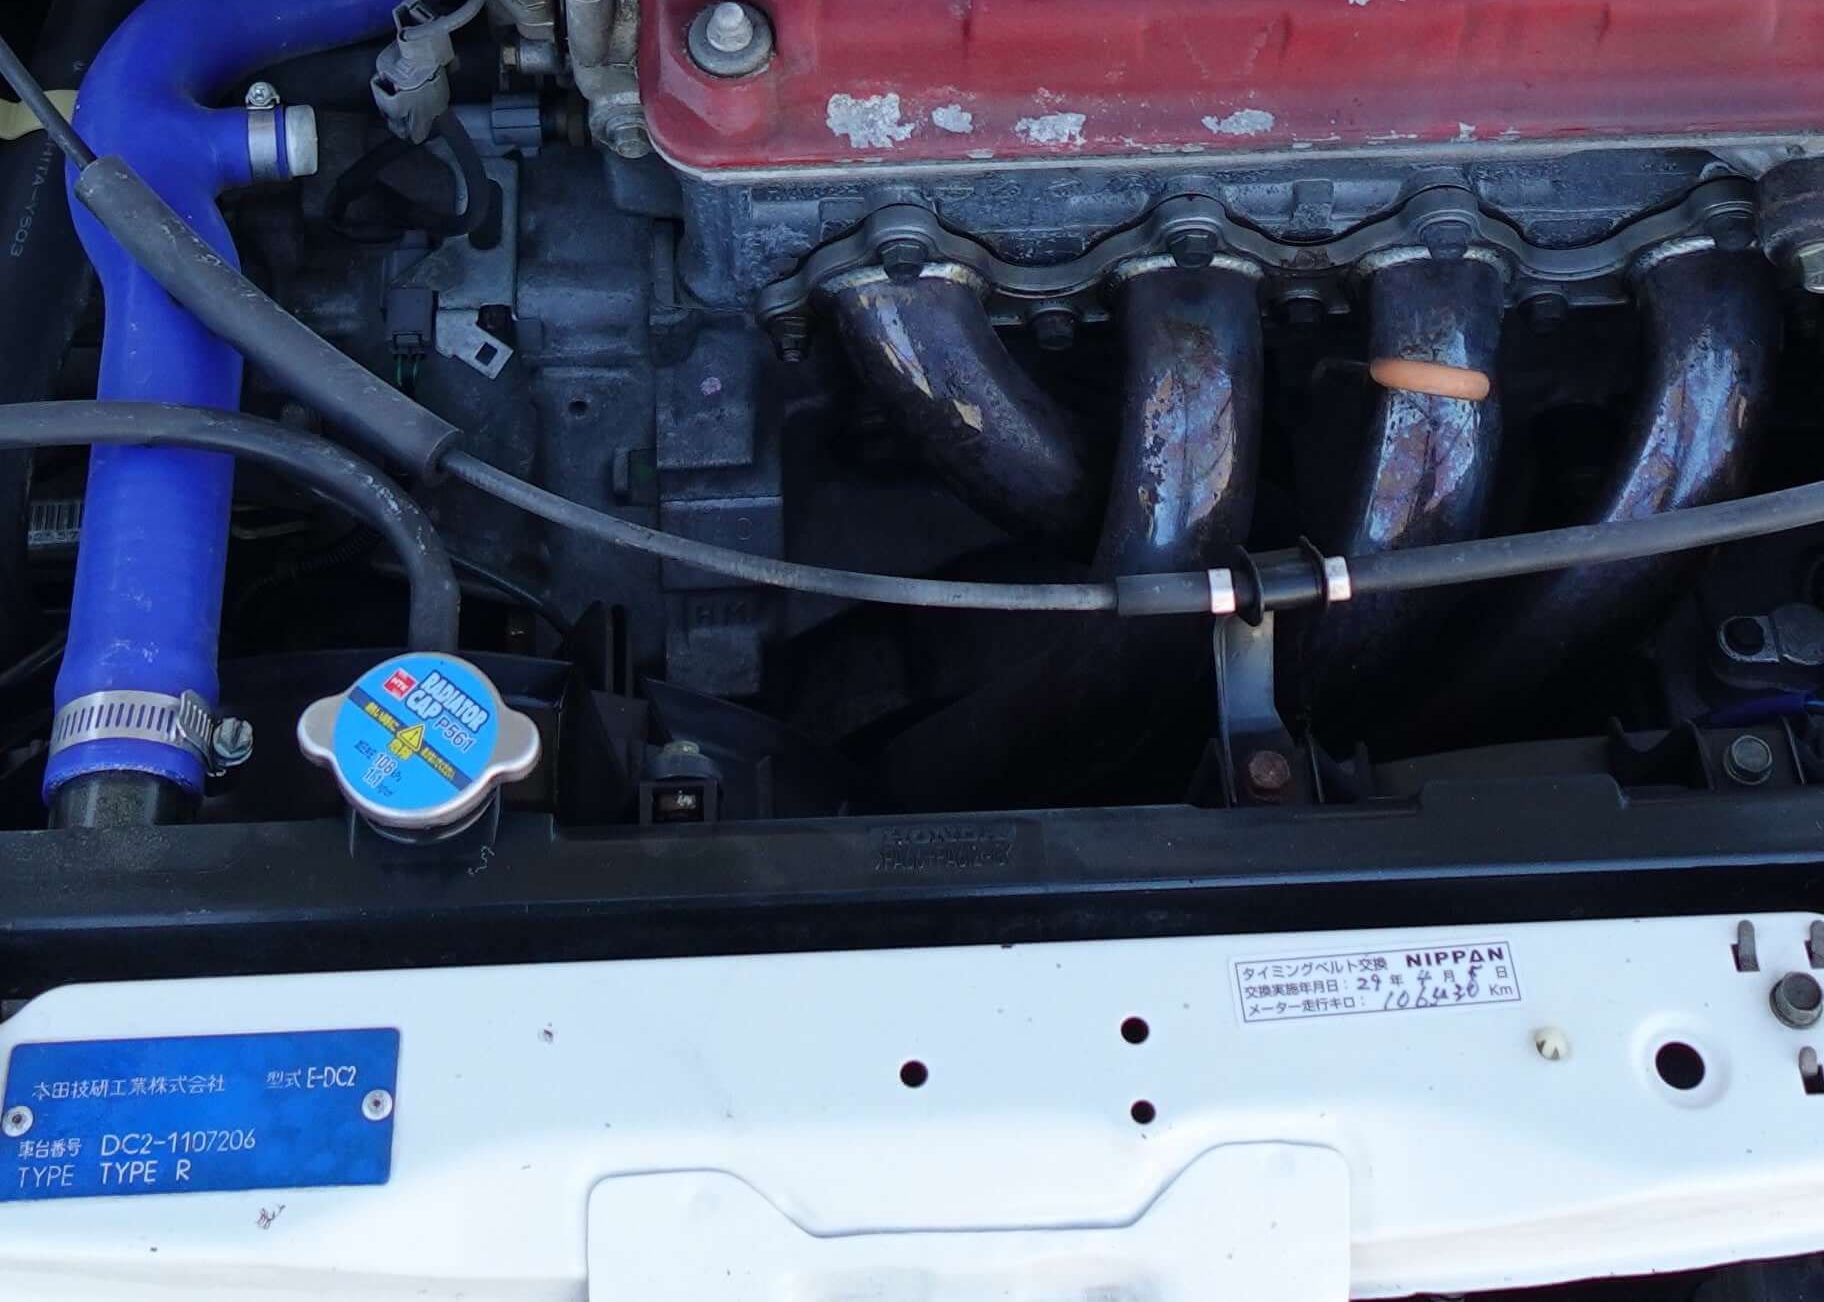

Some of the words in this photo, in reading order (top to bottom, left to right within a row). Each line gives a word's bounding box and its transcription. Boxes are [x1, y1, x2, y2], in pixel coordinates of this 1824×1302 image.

[422, 670, 489, 733] RADIATOR
[405, 689, 441, 720] CAP
[435, 715, 476, 752] P561
[1243, 956, 1388, 981] タイミングベルト交換
[1405, 947, 1505, 969] NIPPAN
[1495, 965, 1508, 979] 日
[32, 1075, 226, 1101] 本田技研工業株式会社
[305, 1066, 358, 1090] E-DC2
[17, 1137, 82, 1160] 車台番号
[100, 1129, 257, 1158] DC2-1107206
[17, 1165, 75, 1188] TYPE
[99, 1160, 158, 1185] TYPE
[175, 1159, 191, 1182] R
